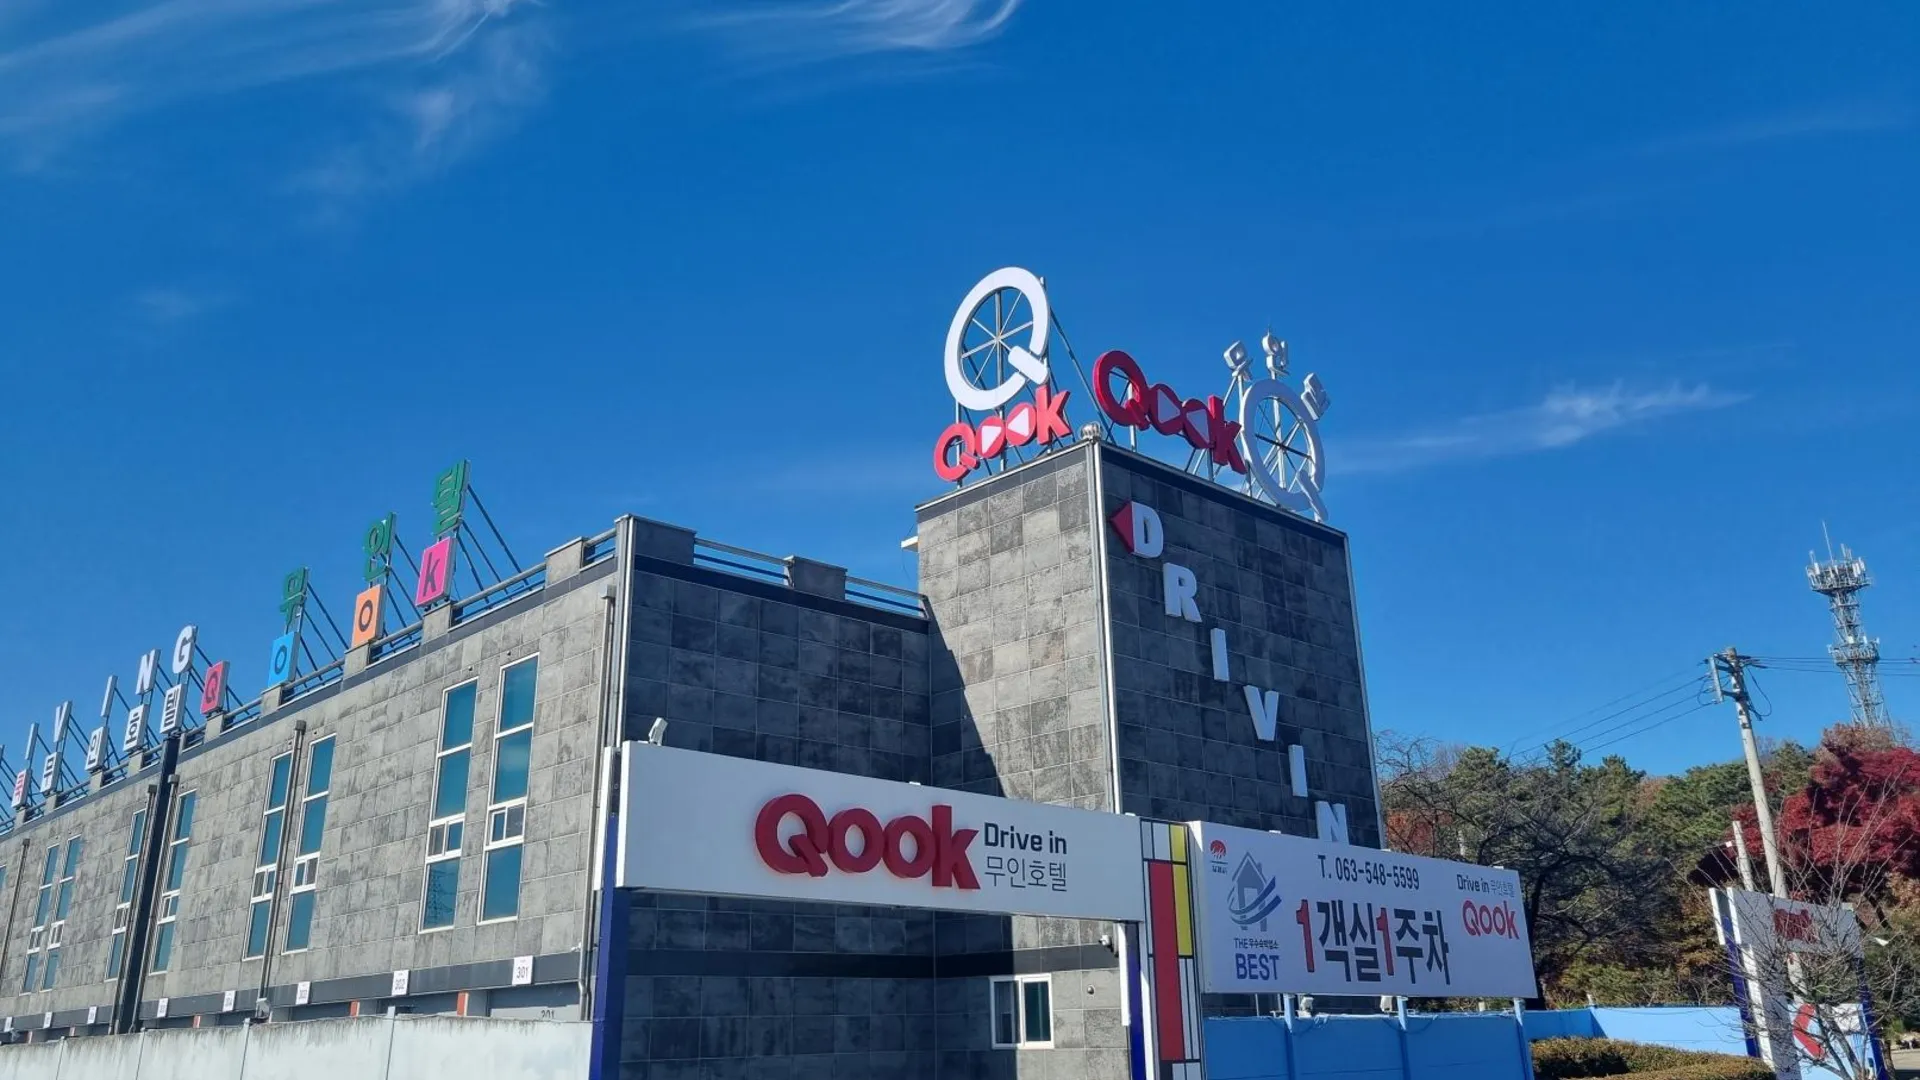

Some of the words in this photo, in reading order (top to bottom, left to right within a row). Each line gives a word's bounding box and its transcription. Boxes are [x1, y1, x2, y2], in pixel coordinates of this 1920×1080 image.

[944, 266, 1050, 411] Q
[1093, 350, 1248, 474] Qook
[933, 384, 1073, 482] Qook
[754, 793, 981, 890] Qook
[984, 822, 1043, 852] Drive
[1049, 829, 1067, 854] in
[985, 856, 1067, 892] 무인호텔
[1335, 857, 1420, 891] 063-548-5599
[1457, 873, 1481, 892] Drive
[1481, 877, 1490, 894] in
[1462, 897, 1520, 939] Qook
[516, 966, 529, 979] 301
[1235, 952, 1280, 981] BEST
